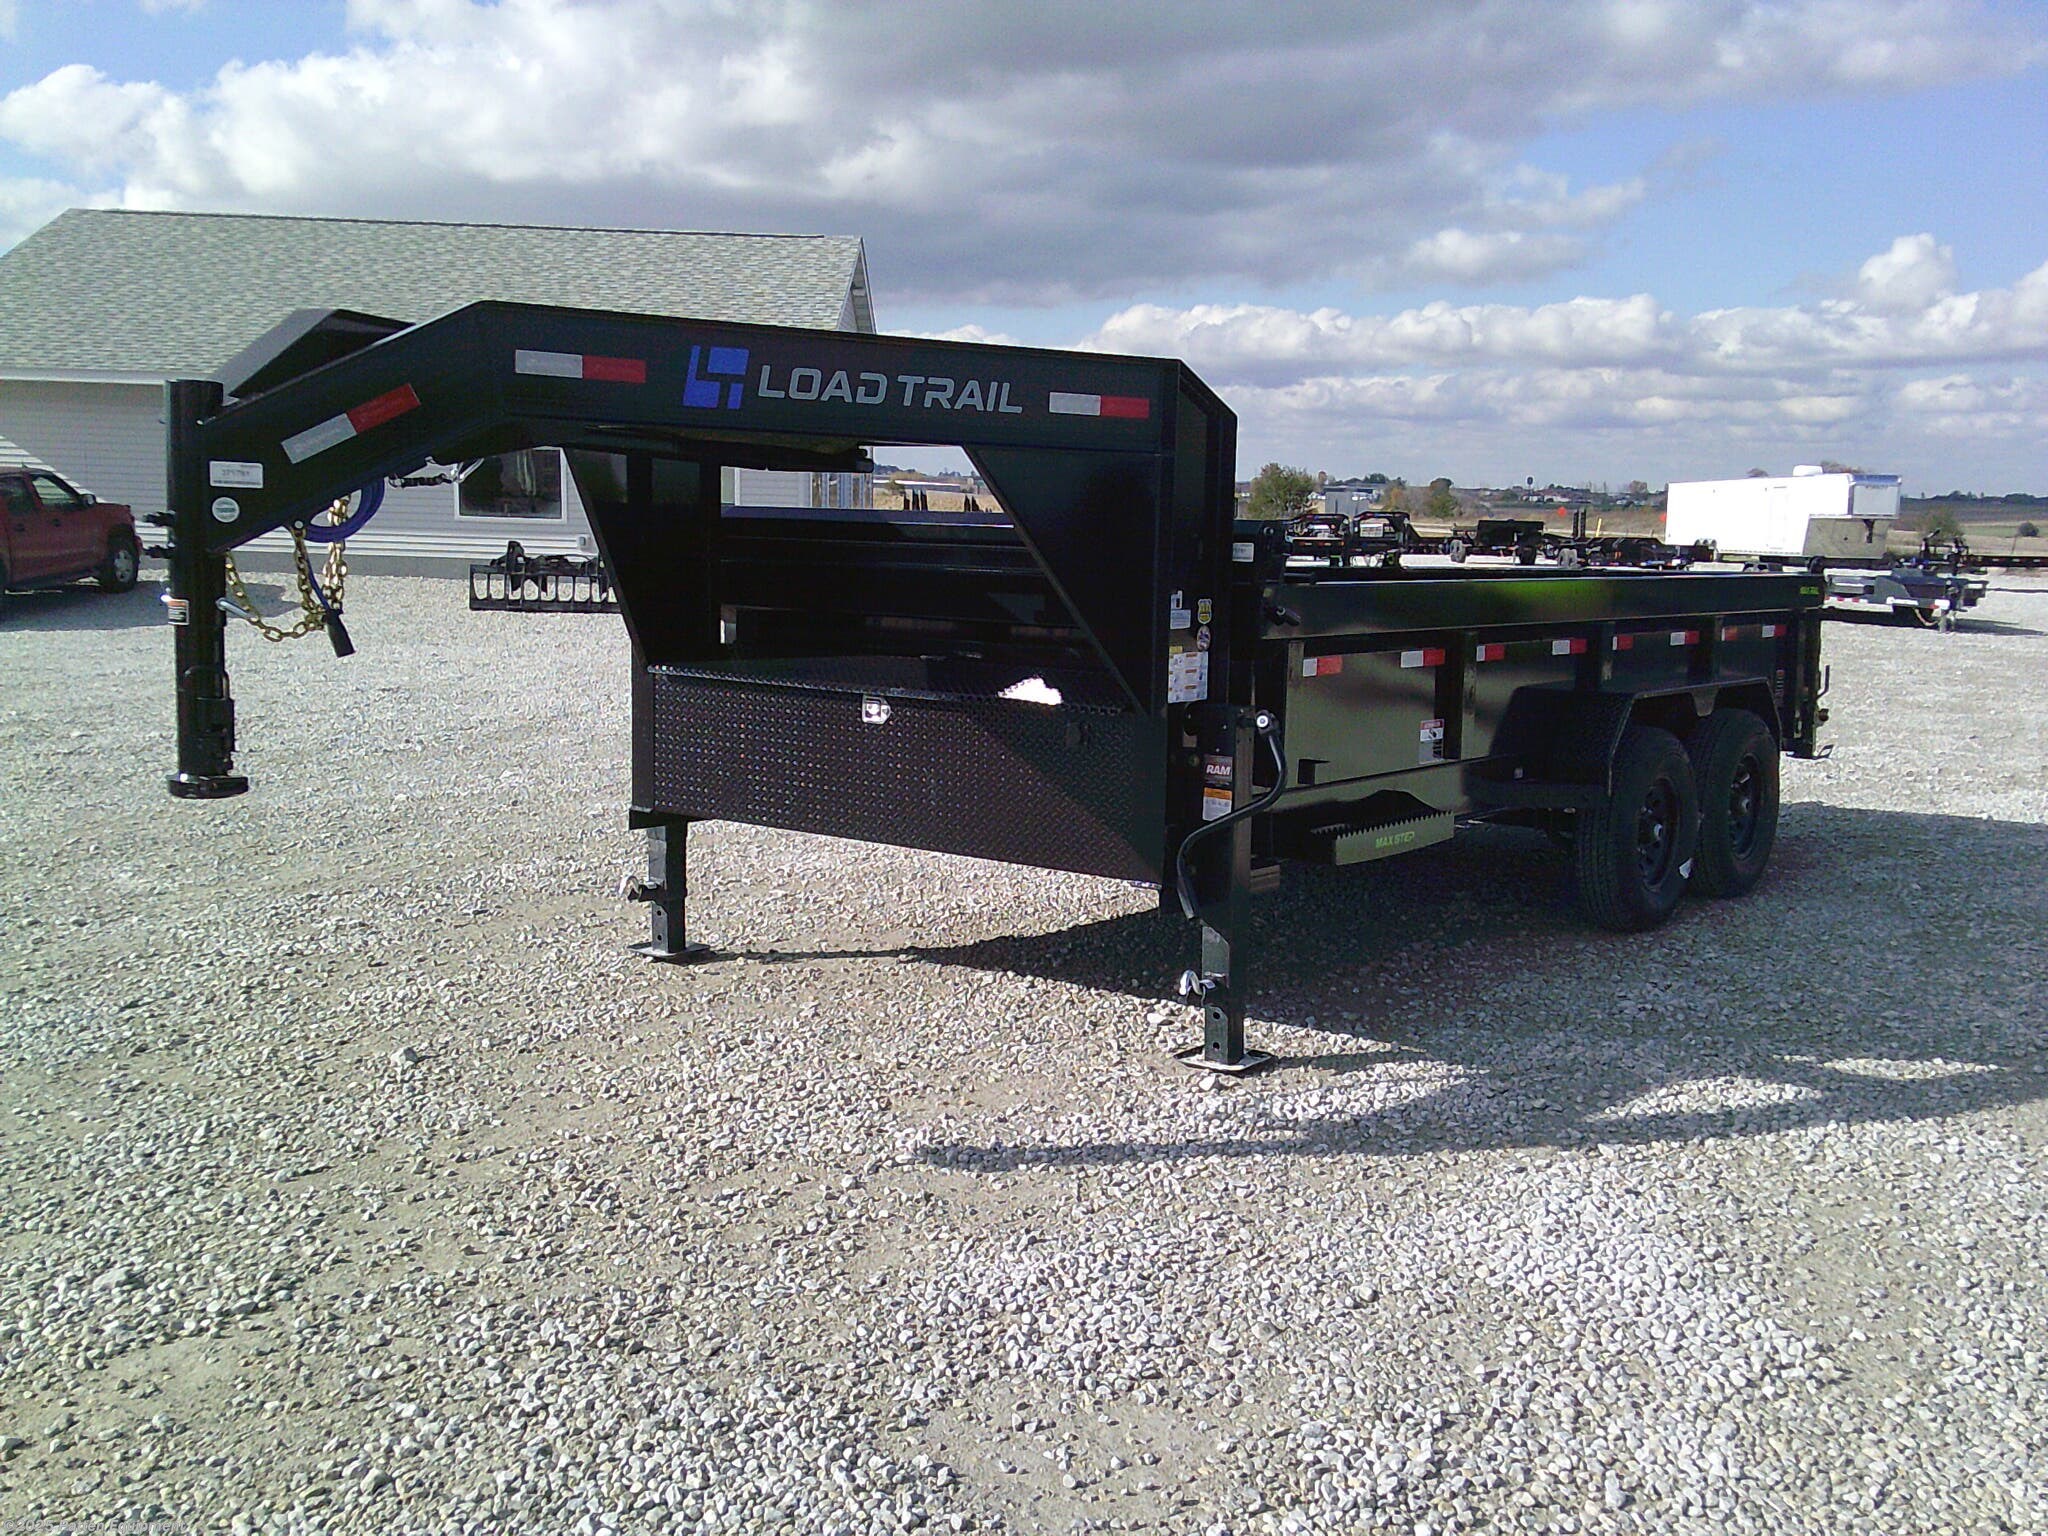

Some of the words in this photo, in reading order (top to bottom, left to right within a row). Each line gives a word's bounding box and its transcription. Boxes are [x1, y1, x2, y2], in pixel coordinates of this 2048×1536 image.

[757, 364, 888, 405] LOAD
[897, 374, 1024, 414] TRAIL
[1206, 764, 1231, 776] RAM
[1375, 835, 1393, 849] MAX
[1394, 831, 1415, 845] STEP
